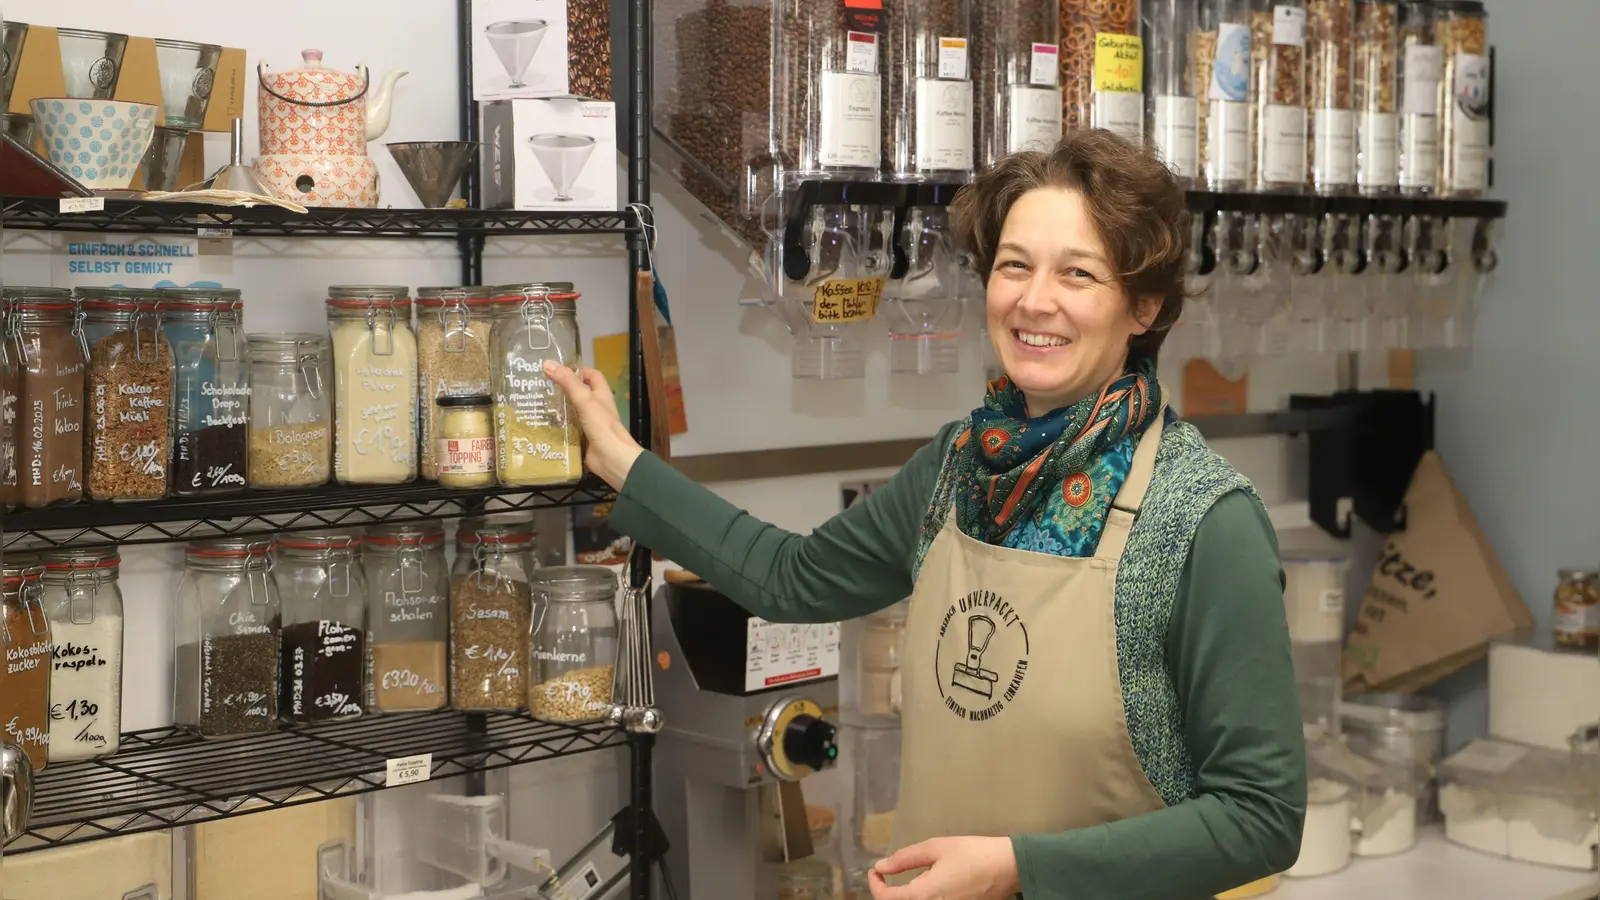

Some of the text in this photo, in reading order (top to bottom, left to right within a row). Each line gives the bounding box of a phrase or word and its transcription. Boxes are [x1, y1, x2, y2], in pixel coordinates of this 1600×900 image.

[69, 243, 194, 256] EINFACH & SCHNELL
[69, 261, 172, 273] SELBST GEMIXT
[513, 358, 543, 372] Past
[118, 383, 161, 395] Kakao-
[212, 398, 240, 412] Drops
[119, 410, 150, 422] Müsli
[472, 439, 494, 451] FAIRES
[449, 451, 482, 464] TOPPING
[389, 607, 433, 622] schalen
[466, 603, 511, 620] Sesam
[939, 589, 1019, 637] ANSBACH UNVERPACKT
[318, 620, 352, 637] Floh-
[52, 642, 98, 659] Kokos-
[8, 658, 41, 674] zucker
[55, 655, 107, 671] raspeln
[945, 660, 1028, 721] EINFACH NACHHALTIG EINKAUFEN
[404, 769, 419, 778] 5,90
